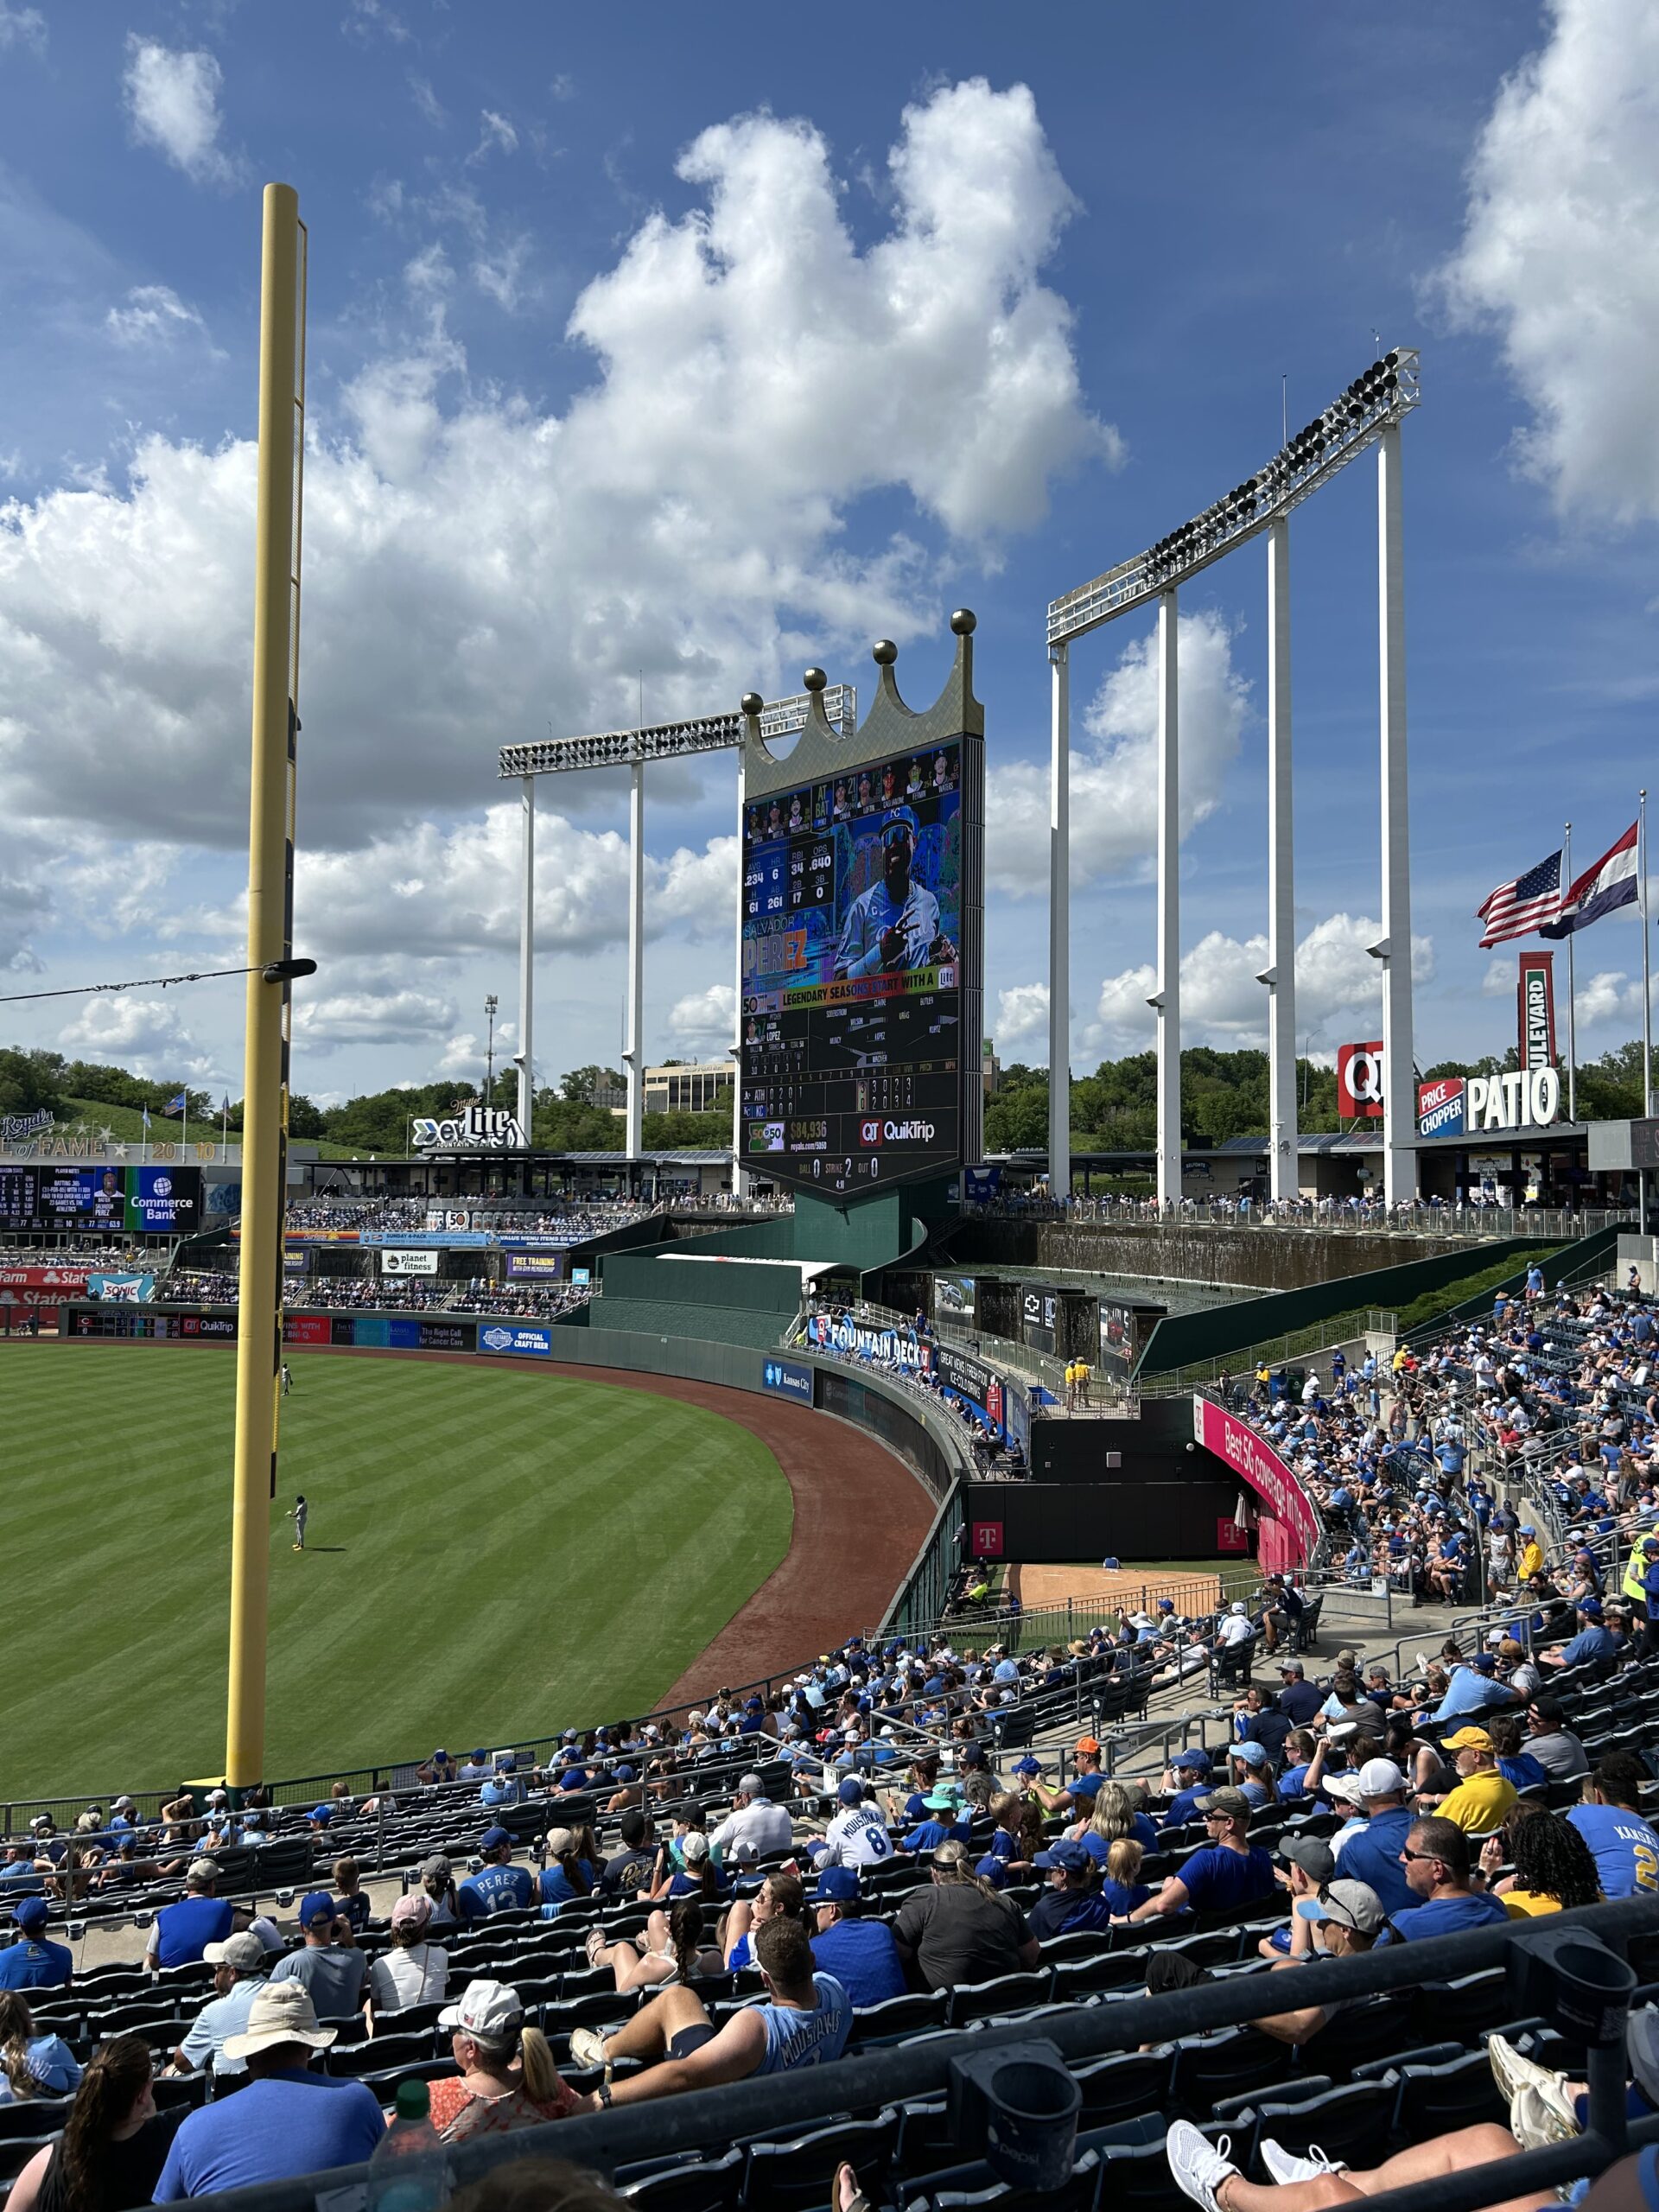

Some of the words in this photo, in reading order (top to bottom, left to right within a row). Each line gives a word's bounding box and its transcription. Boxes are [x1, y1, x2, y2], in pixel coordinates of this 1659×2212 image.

[817, 784, 828, 801] AT
[815, 800, 830, 818] BAT
[747, 861, 761, 872] AVG
[771, 856, 780, 866] HR
[791, 850, 804, 861] RBI
[813, 844, 828, 855] OPS
[744, 872, 764, 887] .234
[772, 868, 779, 880] 6
[791, 861, 804, 875] 34
[809, 855, 831, 871] .640
[792, 880, 802, 889] 2B
[815, 874, 825, 884] 3B
[749, 901, 759, 913] 61
[767, 895, 783, 910] 261
[792, 892, 802, 904] 17
[816, 887, 823, 899] 0
[745, 916, 795, 938] SALVADOR
[743, 928, 808, 978] PEREZ
[783, 988, 828, 1005] LEGENDARY
[830, 983, 869, 999] SEASONS
[872, 977, 899, 993] START
[901, 973, 926, 988] WITH
[926, 972, 934, 985] A
[743, 996, 758, 1014] 50
[1529, 980, 1548, 1070] ULEVARD
[766, 1031, 781, 1041] LOPEZ
[763, 1065, 767, 1074] 2
[754, 1089, 766, 1102] ATH
[779, 1087, 783, 1100] 2
[872, 1079, 877, 1093] 3
[882, 1078, 887, 1092] 0
[894, 1077, 899, 1091] 2
[906, 1077, 912, 1090] 3
[1421, 1082, 1446, 1112] PRICE
[1467, 1066, 1560, 1131] PATIO
[450, 1096, 483, 1116] Miller
[755, 1104, 764, 1117] KC
[872, 1096, 877, 1109] 2
[882, 1096, 887, 1109] 0
[894, 1095, 899, 1108] 3
[906, 1094, 911, 1107] 4
[1, 1109, 54, 1140] Royals
[462, 1106, 511, 1141] Lite
[1421, 1098, 1463, 1135] CHOPPER
[769, 1128, 781, 1140] 50
[790, 1121, 827, 1141] $84,936
[862, 1122, 879, 1142] QT
[883, 1120, 935, 1142] QuikTrip
[16, 1140, 38, 1162] of
[36, 1137, 106, 1158] FAME
[152, 1141, 177, 1160] 20
[194, 1141, 215, 1160] 10
[798, 1164, 811, 1174] BALL
[813, 1158, 821, 1179] 0
[825, 1163, 843, 1174] STRIKE
[845, 1157, 852, 1179] 2
[858, 1160, 869, 1173] OUT
[871, 1157, 879, 1178] 0
[130, 1196, 194, 1210] Commerce
[146, 1208, 177, 1221] Bank
[284, 1252, 304, 1261] AINING
[401, 1254, 427, 1264] planet
[404, 1262, 432, 1270] fitness
[512, 1256, 527, 1266] FREE
[528, 1257, 555, 1267] TRAINING
[105, 1286, 138, 1296] SONIC
[200, 1320, 234, 1333] QuikTrip
[421, 1326, 433, 1337] The
[433, 1327, 449, 1338] Right
[449, 1328, 461, 1338] Call
[518, 1332, 544, 1341] OFFICIAL
[419, 1336, 428, 1345] for
[429, 1337, 449, 1346] Cancer
[450, 1338, 464, 1347] Care
[513, 1339, 533, 1349] CRAFT
[533, 1341, 549, 1350] BEER
[831, 1324, 891, 1357] FOUNTAIN
[893, 1338, 921, 1367] DECK
[940, 1351, 953, 1367] GREAT
[953, 1356, 965, 1373] VIEWS
[966, 1363, 978, 1380] FRESH
[783, 1372, 801, 1389] Kansas
[800, 1377, 810, 1394] City
[1224, 1421, 1243, 1465] Best
[1243, 1434, 1254, 1476] 5G
[1255, 1454, 1286, 1517] coverage
[979, 1528, 996, 1549] T
[503, 1789, 518, 1800] PERE
[866, 1827, 887, 1856] 8
[1612, 1825, 1659, 1850] KANSAS
[1632, 1843, 1659, 1892] 2
[477, 1873, 519, 1893] PEREZ
[486, 1890, 518, 1912] 13
